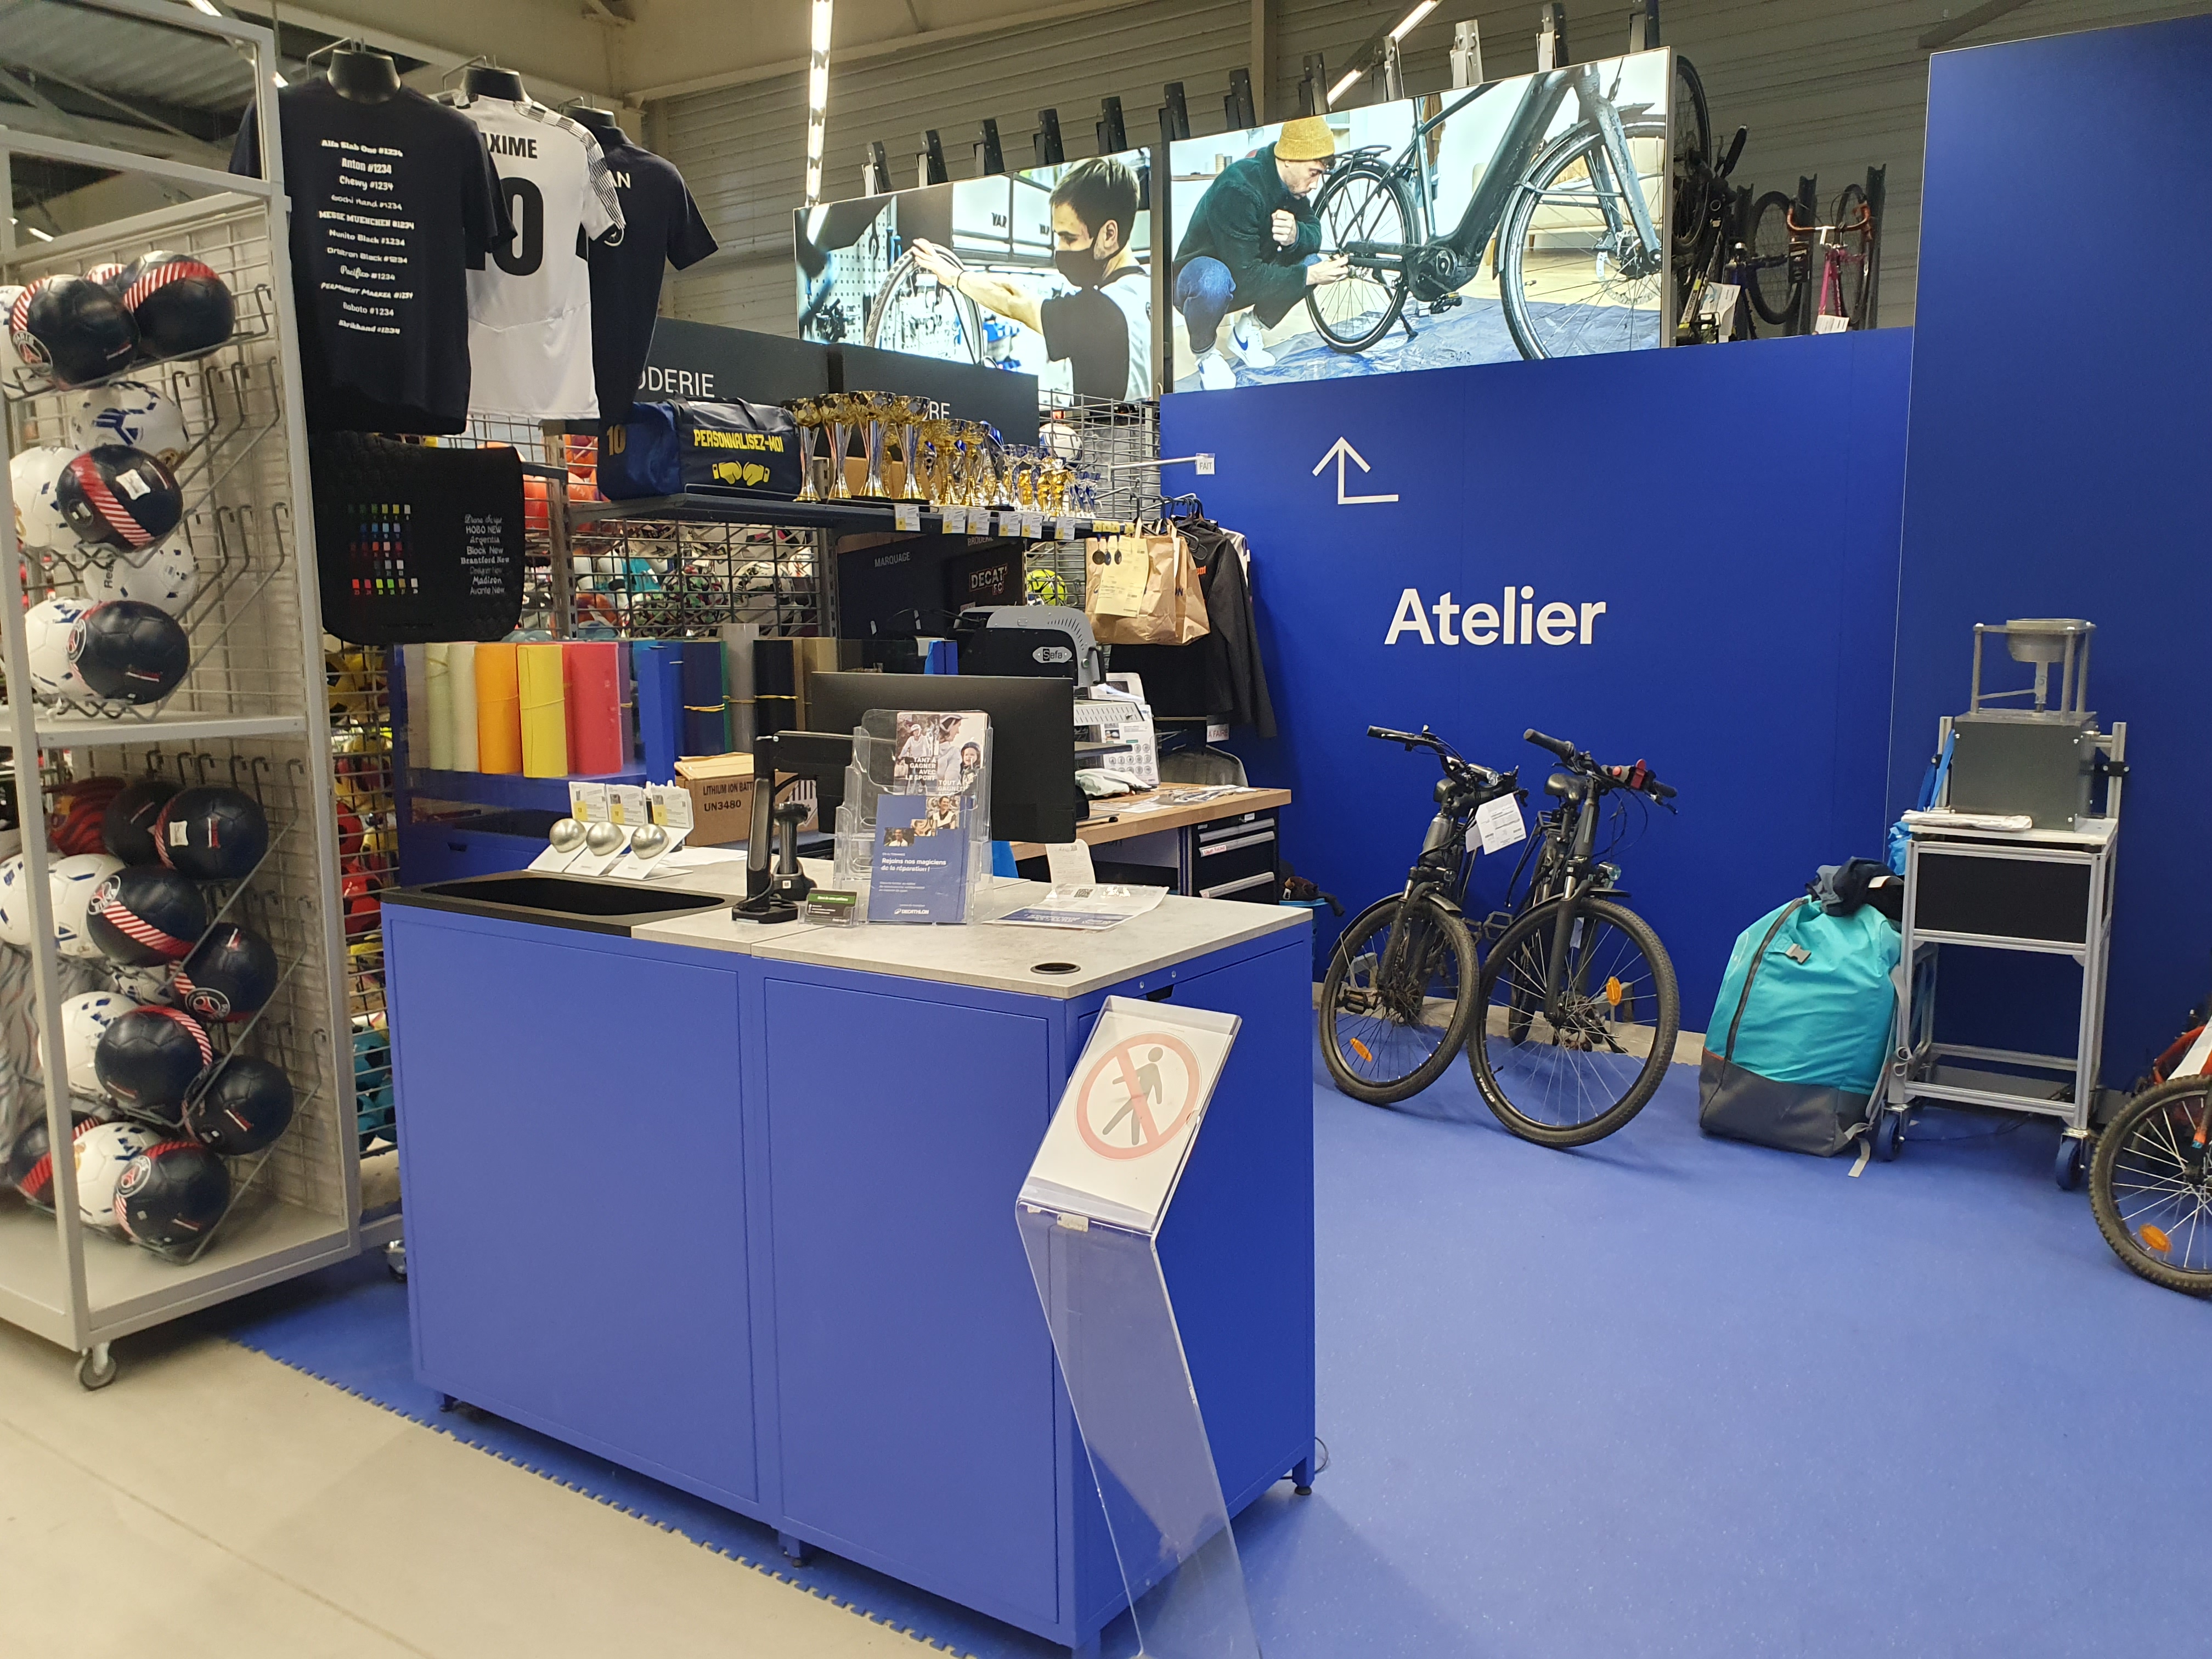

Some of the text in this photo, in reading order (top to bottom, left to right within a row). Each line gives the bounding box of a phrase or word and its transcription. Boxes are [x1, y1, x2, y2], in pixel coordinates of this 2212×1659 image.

[342, 157, 392, 174] Anton #1234
[338, 175, 394, 191] Chewy #1234
[329, 229, 405, 246] Nunito Black #1234
[360, 252, 382, 262] Black
[340, 265, 370, 279] Pacifico
[343, 302, 394, 317] Roboto #1234
[606, 424, 626, 456] 10
[693, 429, 784, 453] PERSONNALISEZ-MOI
[1199, 462, 1212, 470] FAIT
[466, 545, 504, 555] Block New
[874, 551, 911, 567] MARQUAGE
[472, 575, 503, 585] Madison
[993, 582, 1003, 594] FC
[1385, 585, 1606, 645] Atelier
[1043, 649, 1063, 661] Sefa
[1213, 729, 1228, 738] FAIRE
[703, 783, 727, 795] LITHIUM
[728, 783, 738, 793] ION
[704, 800, 741, 812] UN3480
